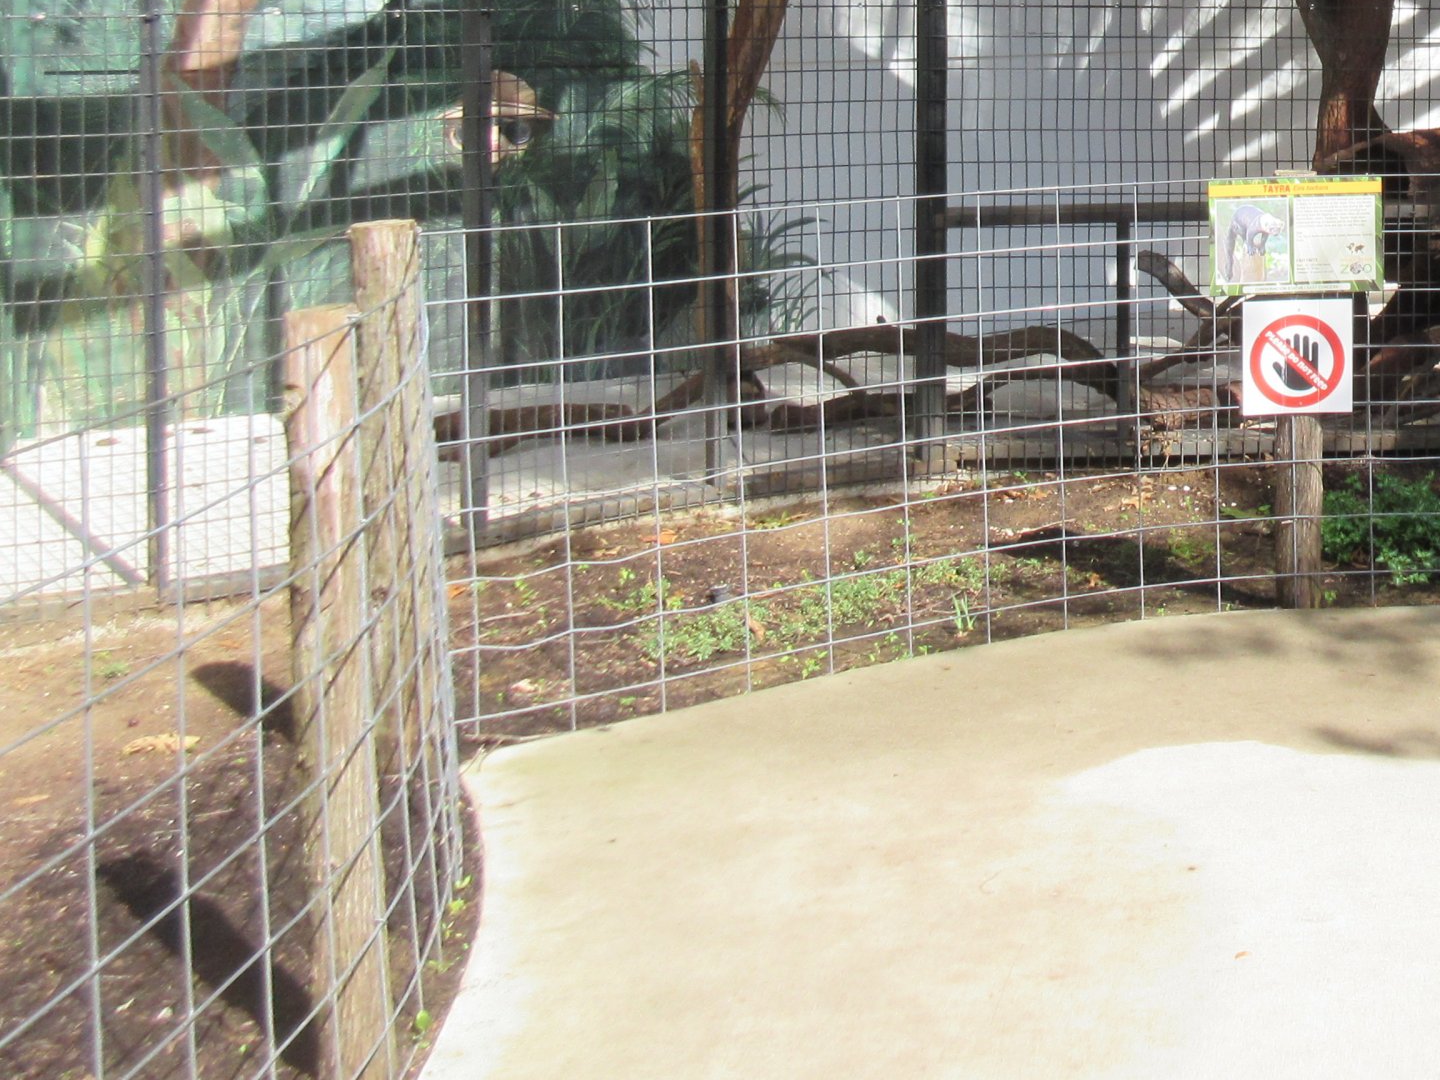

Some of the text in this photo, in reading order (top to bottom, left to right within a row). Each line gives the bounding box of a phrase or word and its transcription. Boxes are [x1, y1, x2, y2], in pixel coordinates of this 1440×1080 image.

[1263, 185, 1291, 193] TAYRA
[1265, 330, 1328, 391] PLEASE DO NOT FEED
